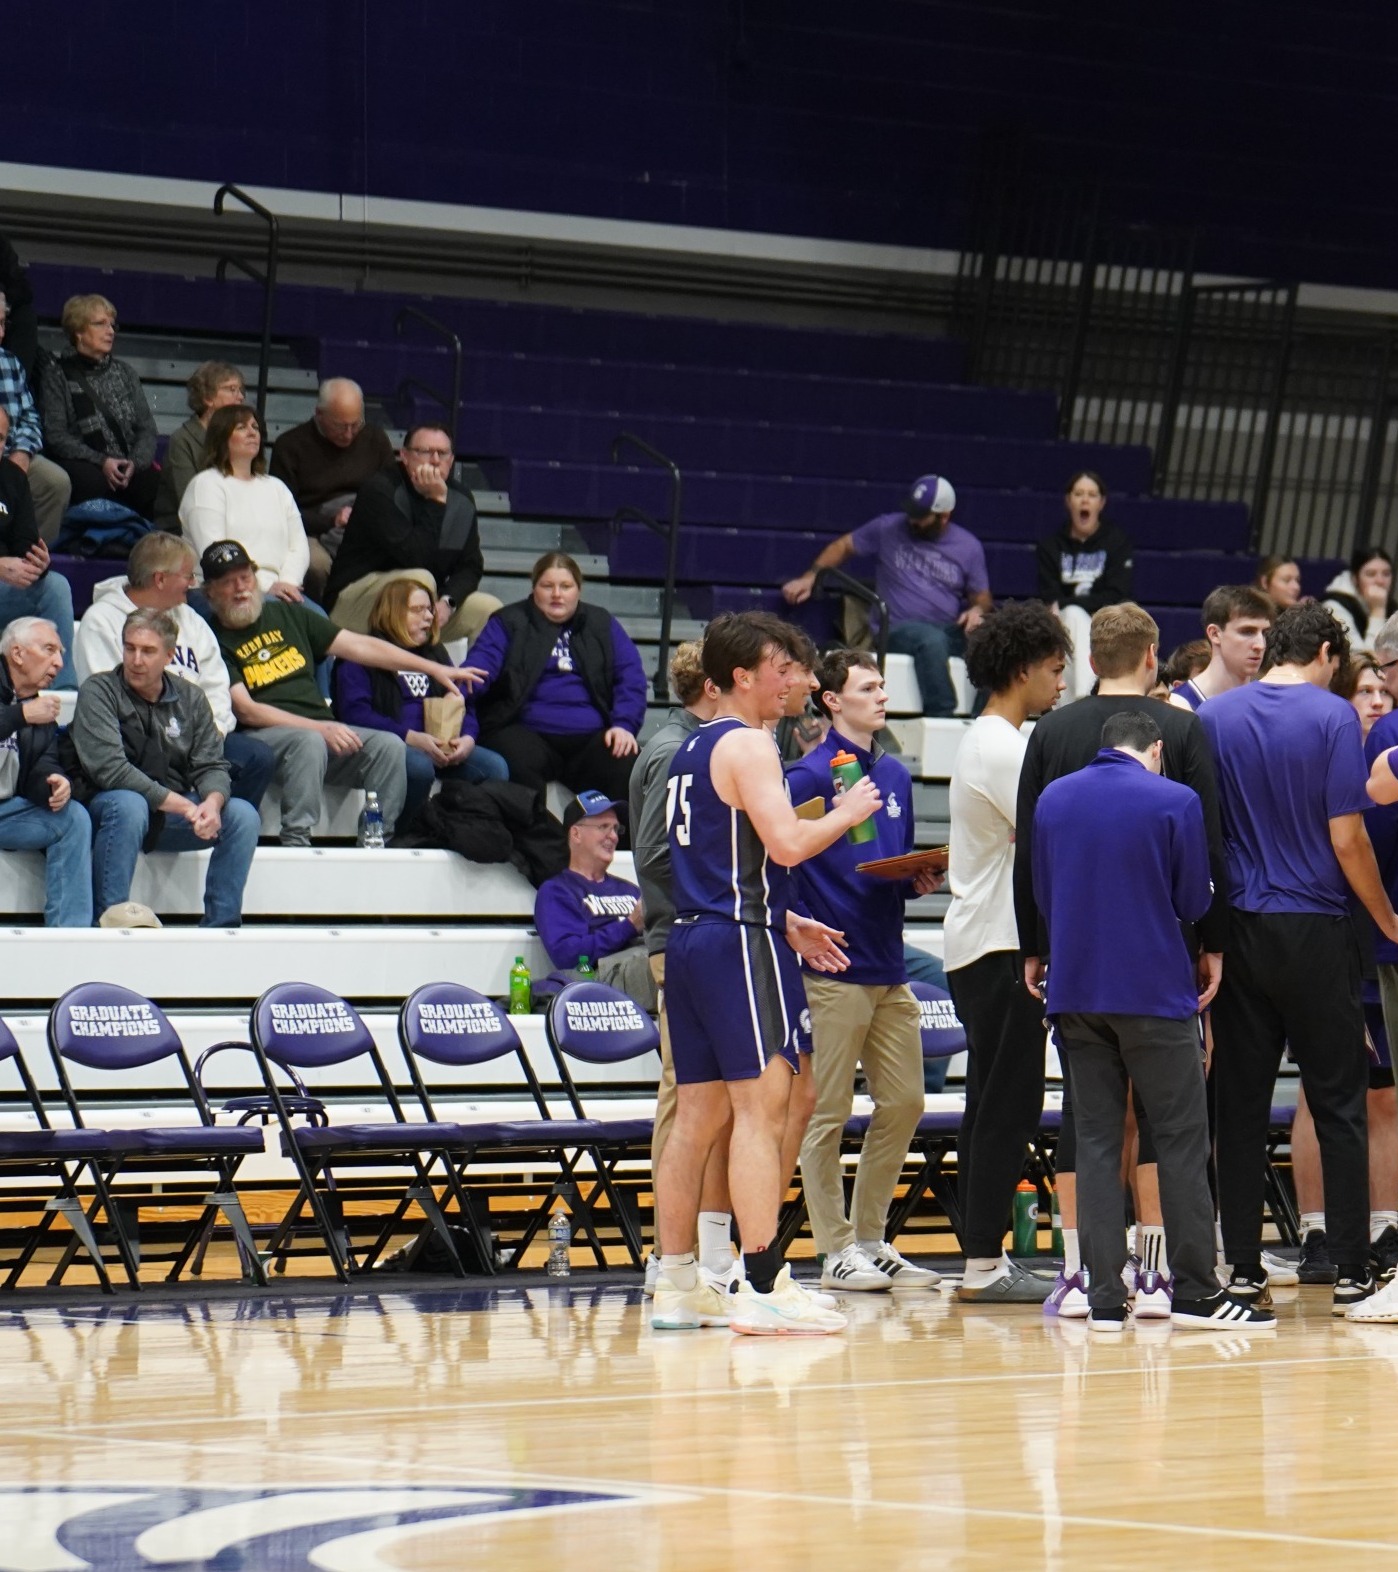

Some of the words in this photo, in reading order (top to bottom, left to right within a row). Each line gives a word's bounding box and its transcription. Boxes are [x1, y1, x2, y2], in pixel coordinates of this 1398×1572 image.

[666, 773, 694, 846] 15
[69, 1004, 153, 1021] GRADUATE
[270, 1001, 348, 1019] GRADUATE
[418, 1002, 495, 1019] GRADUATE
[565, 1000, 637, 1017] GRADUATE
[70, 1019, 162, 1037] CHAMPIONS
[271, 1016, 355, 1035] CHAMPIONS
[420, 1017, 502, 1035] CHAMPIONS
[567, 1014, 645, 1032] CHAMPIONS
